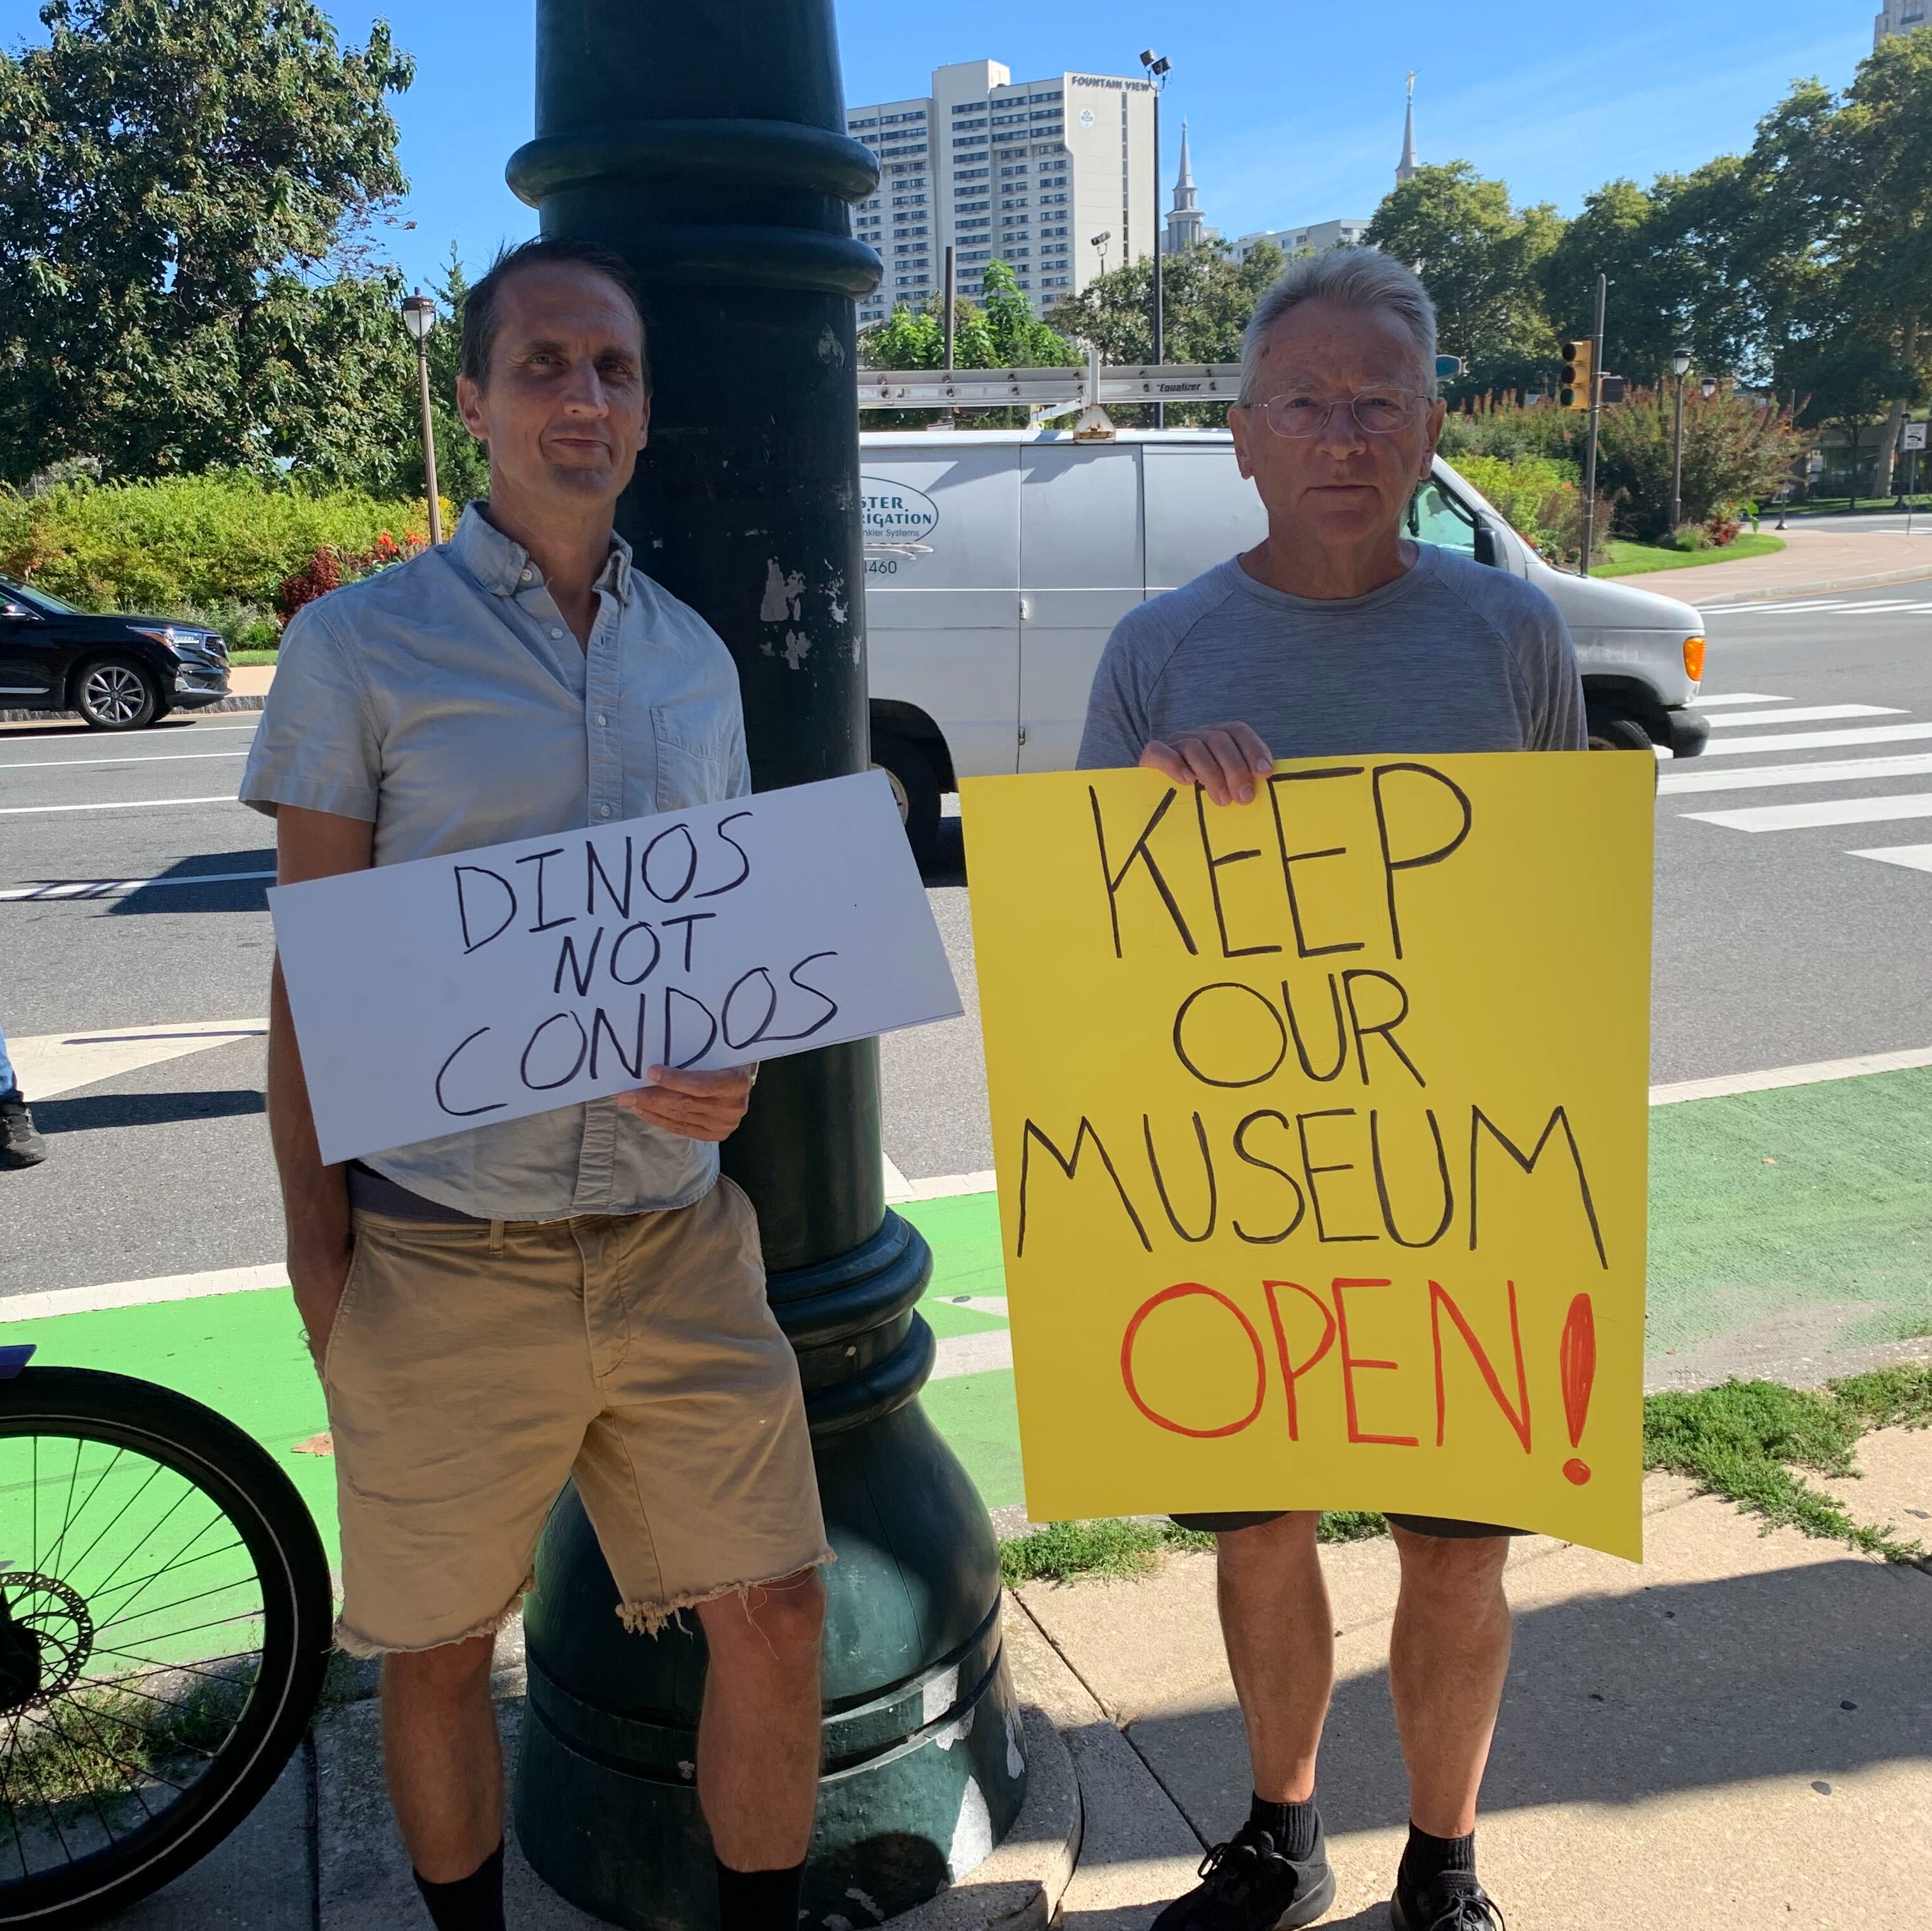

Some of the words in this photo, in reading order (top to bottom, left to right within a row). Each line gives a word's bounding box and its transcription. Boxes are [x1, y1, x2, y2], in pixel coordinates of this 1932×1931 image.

[1071, 76, 1122, 89] FOUNTAIN
[1125, 80, 1150, 91] VIEW
[1159, 383, 1202, 393] Equalizer
[886, 529, 919, 538] Systems
[454, 811, 754, 955] DINOS
[1088, 761, 1472, 960] KEEP
[554, 912, 717, 997] NOT
[435, 950, 838, 1117] CONDOS
[1172, 969, 1426, 1089] OUR
[1016, 1105, 1608, 1271] MUSEUM
[1121, 1277, 1597, 1486] OPEN!
